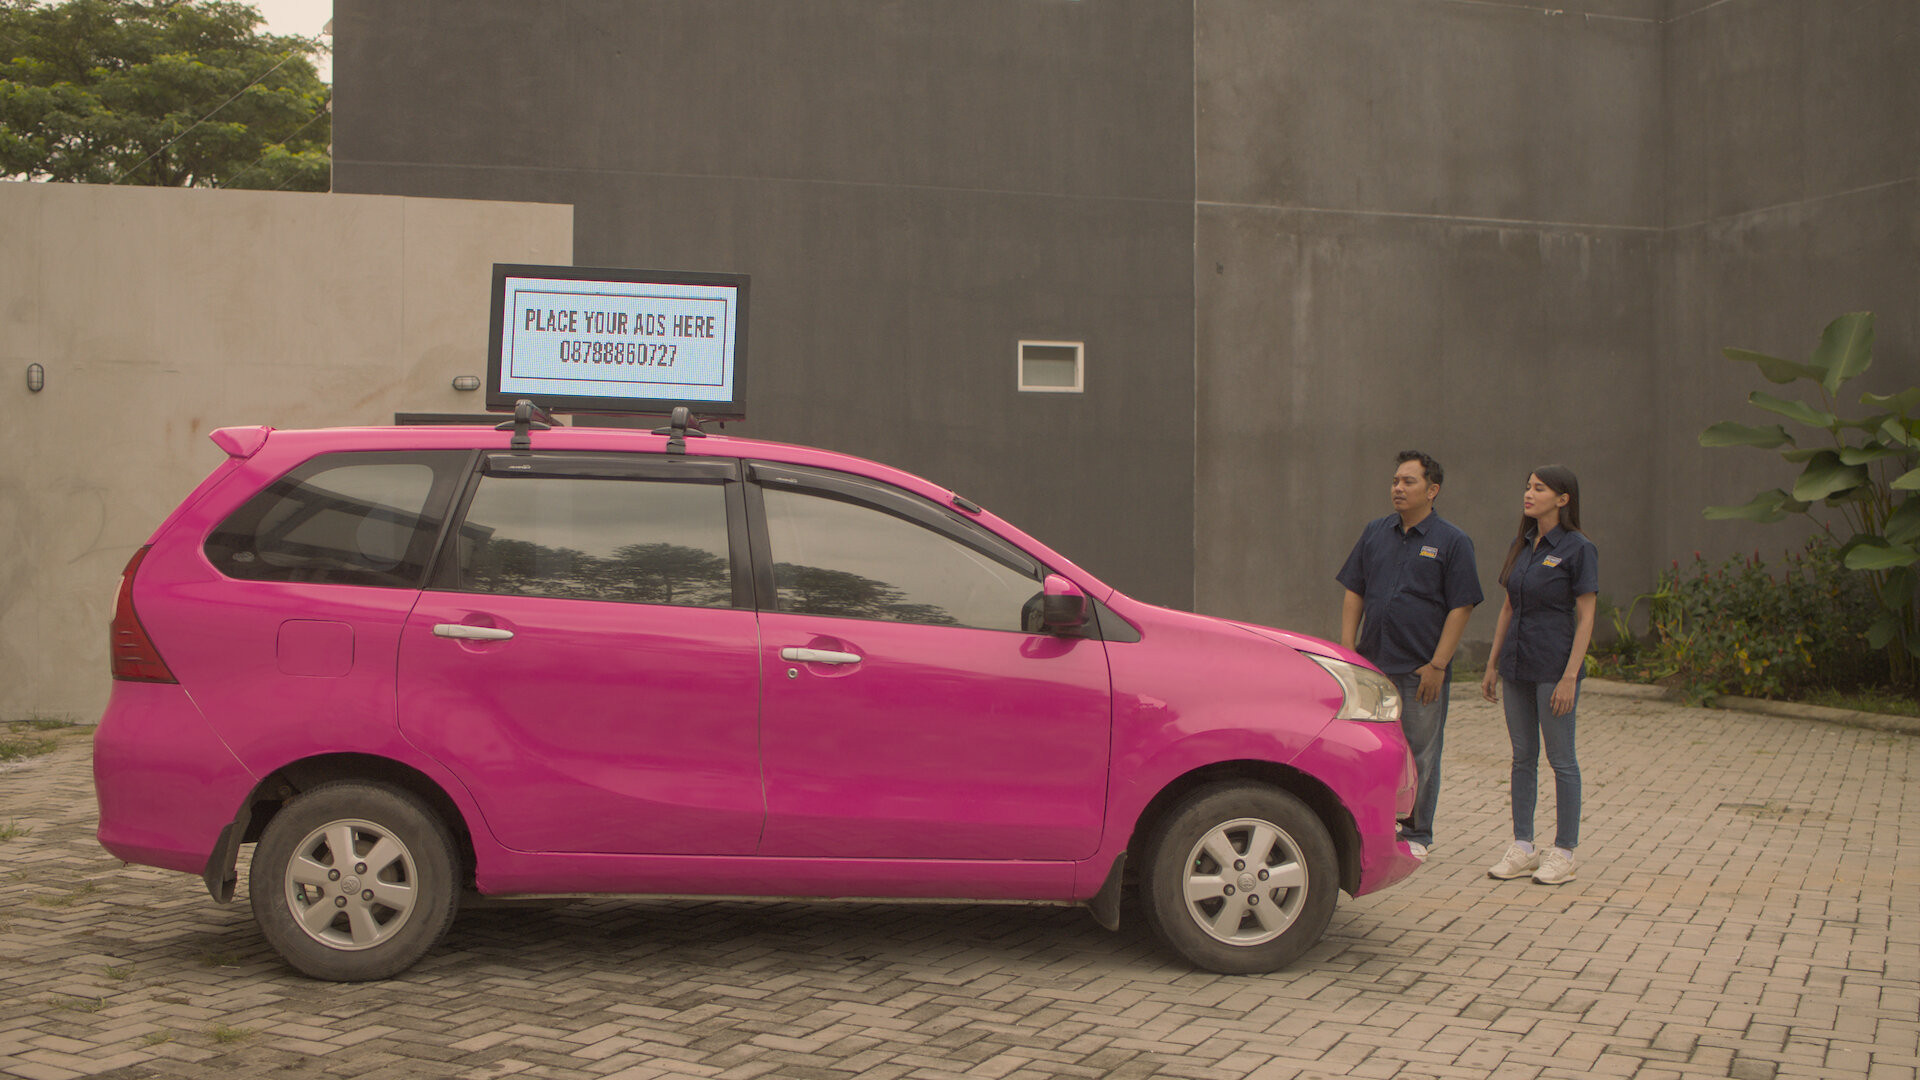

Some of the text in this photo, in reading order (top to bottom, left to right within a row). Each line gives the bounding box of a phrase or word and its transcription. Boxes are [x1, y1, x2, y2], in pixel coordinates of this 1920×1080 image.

[525, 309, 715, 339] PLACE YOUR ADS HERE
[560, 340, 677, 367] 08788860727
